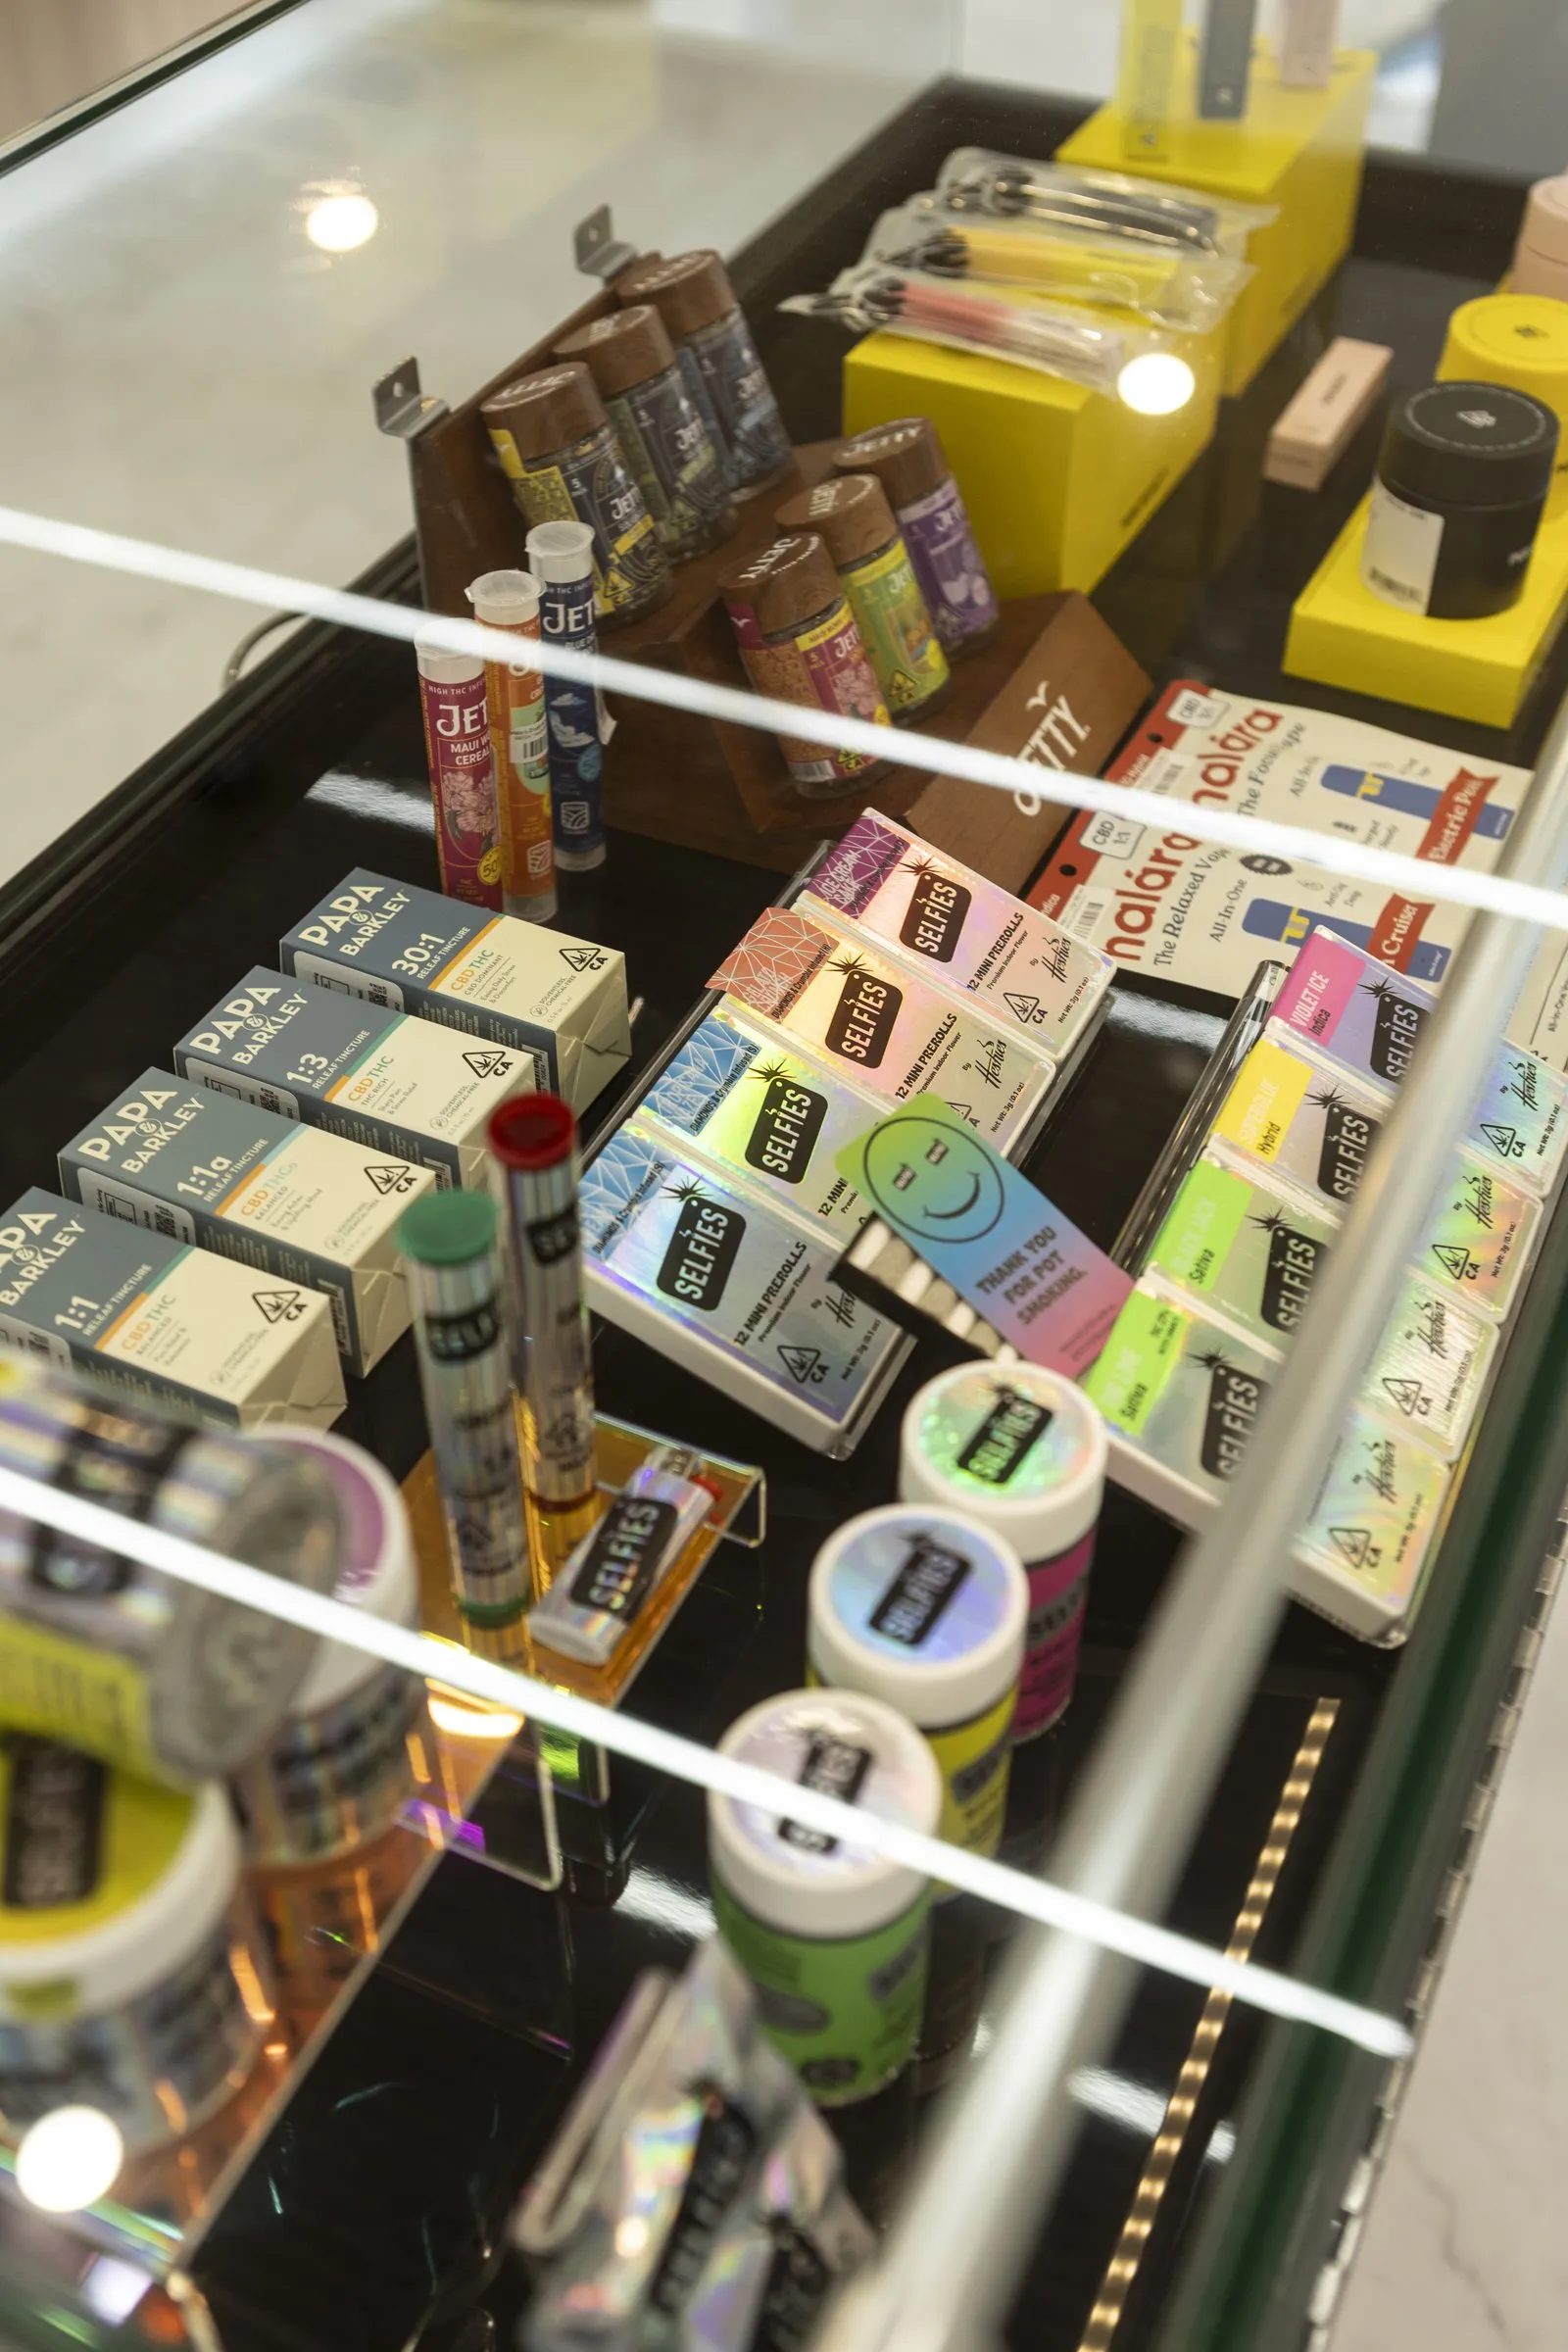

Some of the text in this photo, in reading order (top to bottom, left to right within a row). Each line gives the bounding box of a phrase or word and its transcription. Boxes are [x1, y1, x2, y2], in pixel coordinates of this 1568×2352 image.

[428, 685, 466, 696] HIGH THC
[450, 741, 479, 755] MAUI
[1092, 819, 1115, 846] CBD
[298, 885, 412, 956] PAPA & BARKLEY
[914, 881, 957, 954] SELFIES
[1040, 892, 1060, 918] ndica
[1153, 846, 1232, 967] The Relaxed Vap
[1208, 878, 1248, 944] All-In-One
[1381, 903, 1419, 956] Cruiser
[392, 932, 446, 977] 30:1
[416, 925, 471, 980] RELEAF TINCTURE
[451, 950, 495, 992] CBD THC
[464, 955, 504, 996] CBD DOMINANT
[589, 954, 608, 971] CA
[966, 912, 1024, 992] 12 MINI PREROLLS
[987, 930, 1029, 990] Premium Indoor Flower
[1029, 937, 1072, 984] By Heshies
[545, 974, 577, 1007] CHEMICAL-FREE
[771, 990, 795, 1018] DIAMONDS
[797, 968, 813, 991] Crumble
[1290, 970, 1330, 1027] VIOLET ICE
[189, 986, 282, 1055] PAPA
[231, 992, 310, 1065] BARKLEY
[841, 980, 889, 1059] SELFIES
[1032, 1008, 1049, 1025] CA
[1058, 1012, 1067, 1024] Net
[1308, 1008, 1332, 1037] Indica
[1383, 1004, 1419, 1078] SELFIES
[286, 1052, 329, 1085] 1:3
[312, 1029, 370, 1091] RELEAF TINCTURE
[493, 1059, 514, 1077] CA
[895, 1013, 957, 1100] 12 MINI PREROLLS
[936, 1032, 962, 1072] Indoor Flower
[961, 1039, 1007, 1089] By Heshies
[348, 1055, 395, 1102] CBD THC
[361, 1077, 389, 1106] THC RICH
[446, 1081, 480, 1118] CHEMICAL-FREE
[689, 1100, 717, 1132] DIAMONDS
[715, 1072, 737, 1099] Crumble
[732, 1053, 753, 1075] Infused
[747, 1043, 760, 1056] (S)
[1499, 1061, 1539, 1111] By Heshies
[77, 1090, 177, 1162] PAPA
[761, 1089, 811, 1173] SELFIES
[991, 1081, 1025, 1133] Net Wt: 3g (0.1 oz)
[121, 1097, 206, 1174] BARKLEY
[1256, 1121, 1282, 1156] Hybrid
[1331, 1113, 1370, 1196] SELFIES
[1511, 1140, 1527, 1157] CA
[176, 1154, 234, 1197] 1:1a
[202, 1138, 270, 1202] RELEAF TINCTURE
[396, 1176, 417, 1194] CA
[240, 1188, 270, 1216] CBD
[254, 1185, 289, 1221] BALANCED
[818, 1201, 833, 1217] 12
[1465, 1175, 1494, 1229] Heshies
[0, 1219, 86, 1305] BARKLEY
[674, 1207, 729, 1299] SELFIES
[975, 1225, 1057, 1296] THANK YOU
[1003, 1250, 1065, 1305] FOR POT
[1189, 1248, 1215, 1286] Sativa
[1465, 1261, 1481, 1280] CA
[1492, 1267, 1501, 1278] Net
[82, 1300, 116, 1337] RELEAF
[111, 1262, 153, 1305] TINCTURE
[734, 1241, 808, 1347] 12 MINI PREROLLS
[759, 1262, 811, 1343] Premium Indoor Flower
[1275, 1238, 1316, 1329] SELFIES
[54, 1295, 100, 1330] 1:1
[121, 1321, 151, 1351] CBD
[145, 1292, 176, 1322] THC
[284, 1302, 308, 1321] CA
[810, 1363, 830, 1384] CA
[1120, 1381, 1149, 1422] Sativa
[1417, 1396, 1433, 1416] CA
[590, 1497, 660, 1610] SELFIES
[1366, 1546, 1383, 1568] CA
